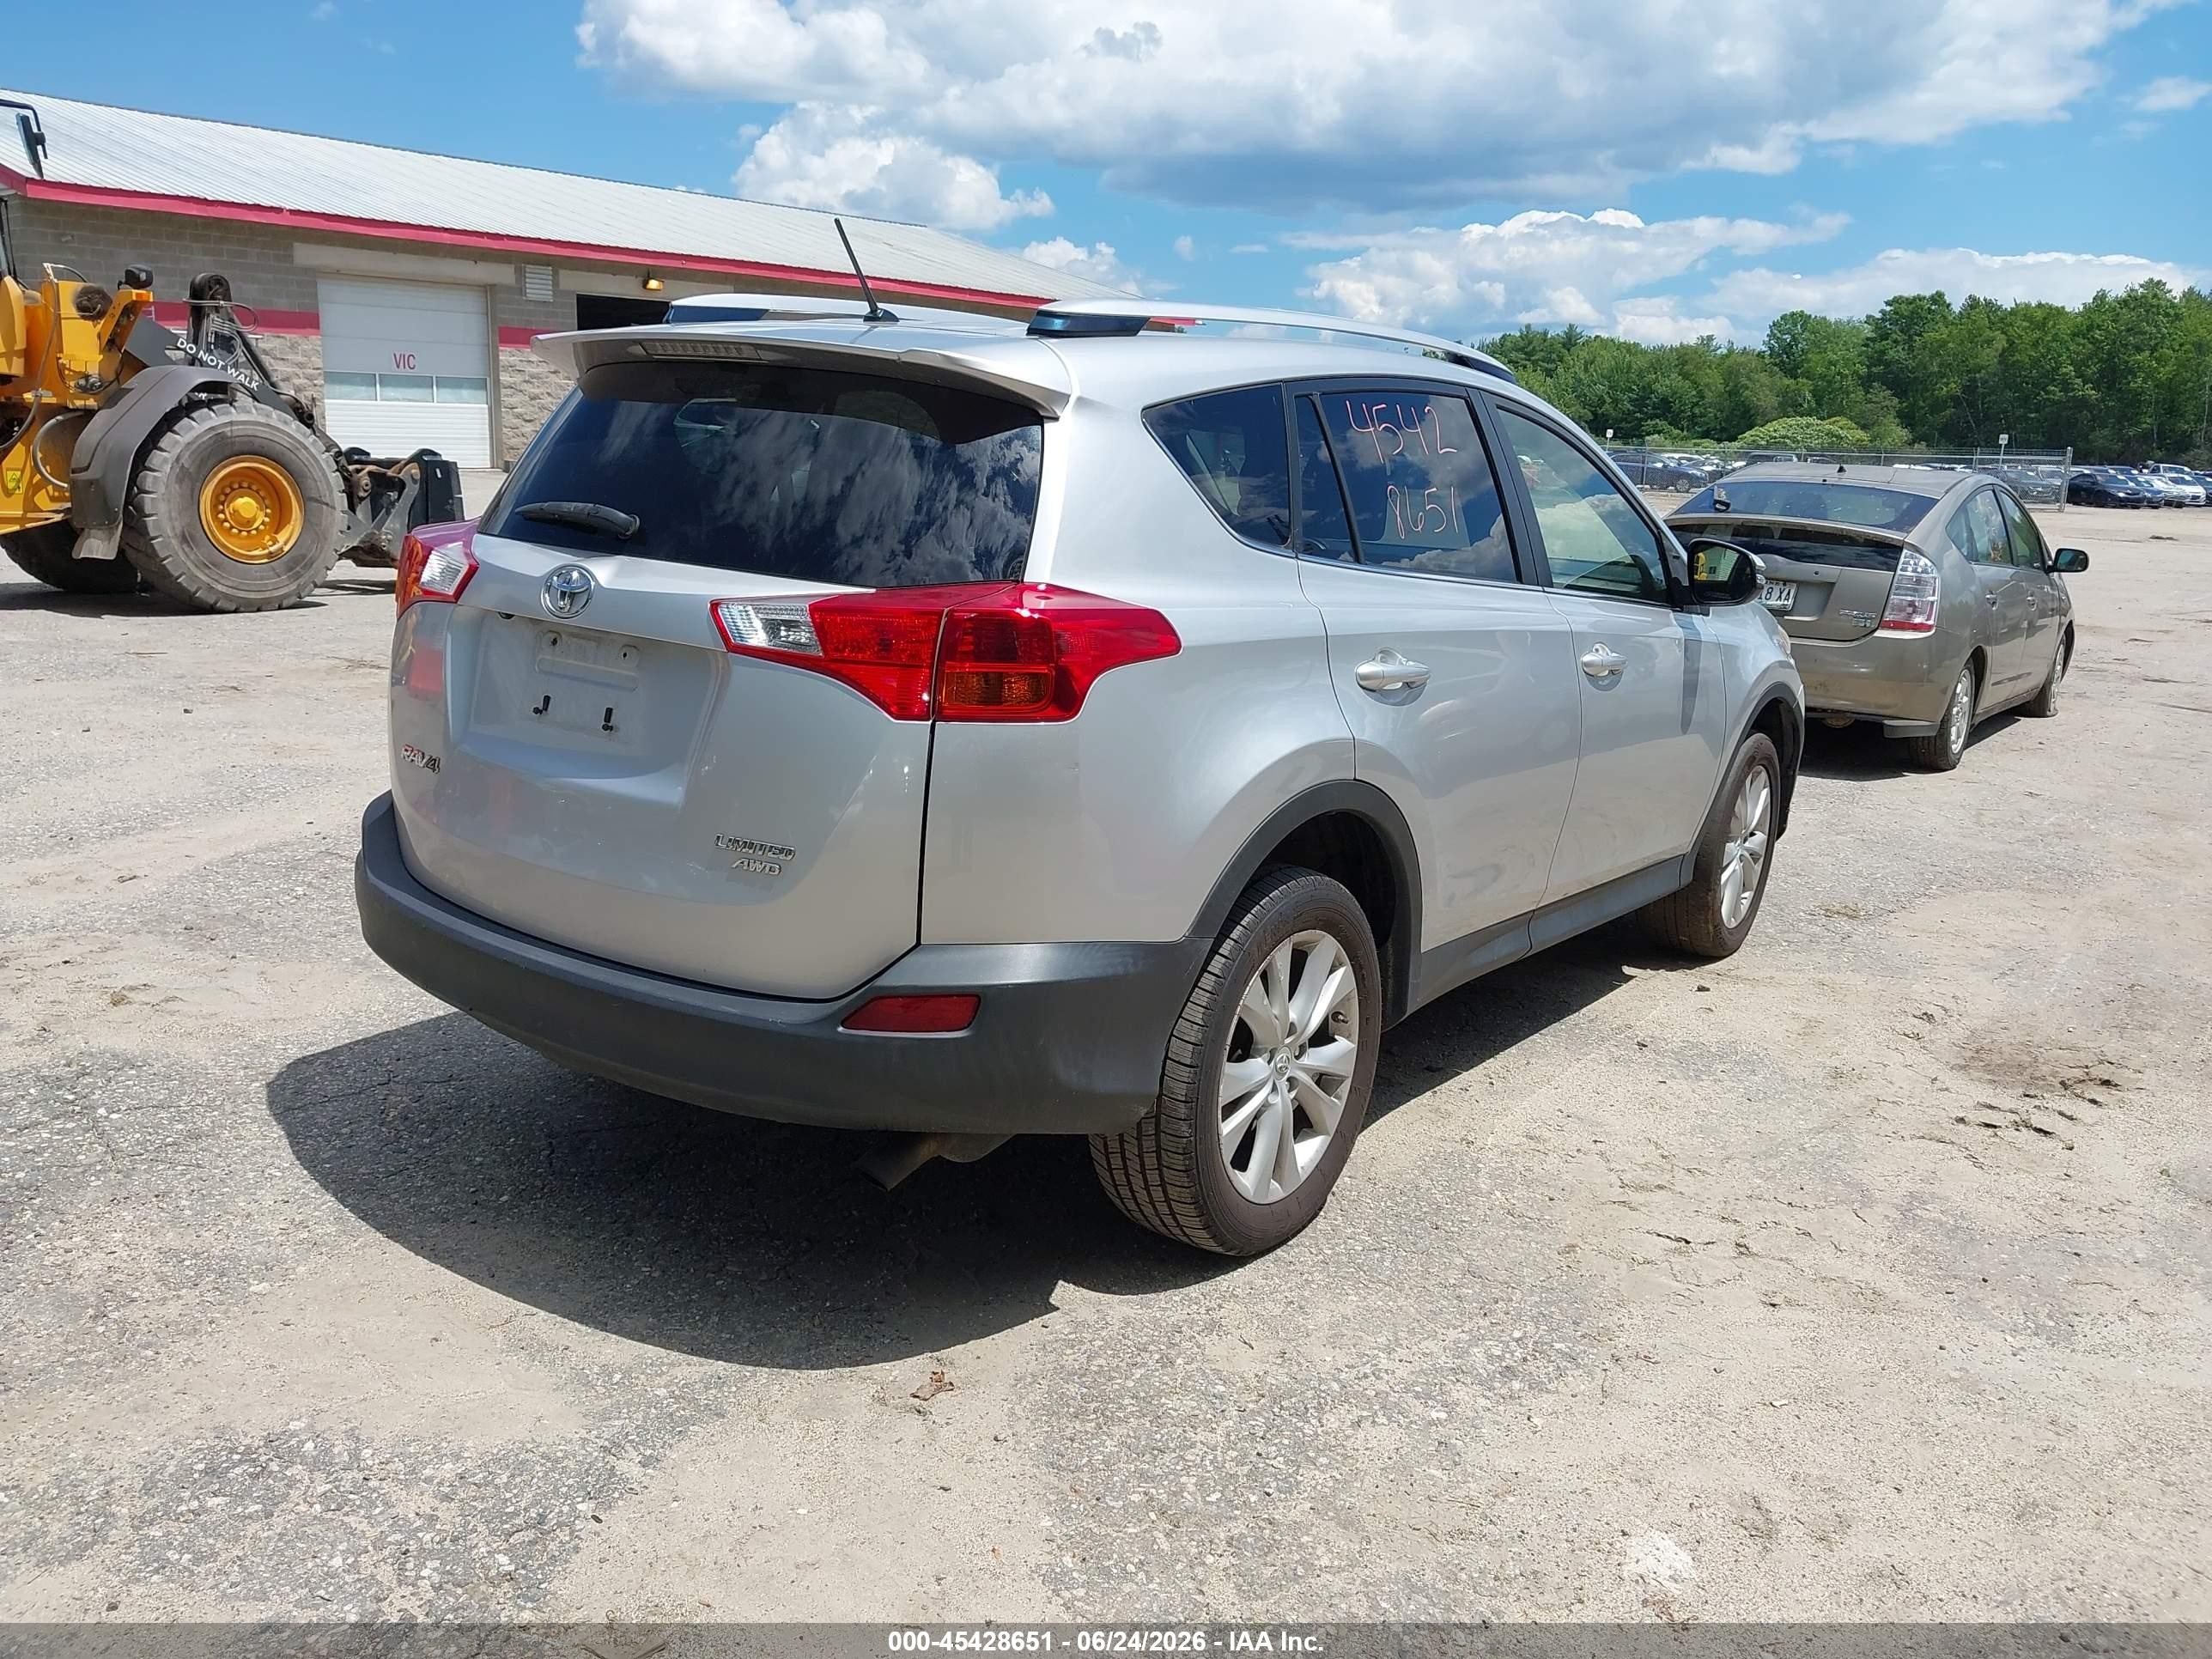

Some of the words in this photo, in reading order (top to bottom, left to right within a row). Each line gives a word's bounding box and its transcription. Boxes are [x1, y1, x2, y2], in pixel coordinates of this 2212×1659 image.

[177, 337, 197, 354] DO
[198, 349, 226, 370] NOT
[227, 365, 260, 392] WALK
[392, 352, 416, 370] VIC
[1346, 400, 1458, 465] 4542
[1387, 485, 1459, 539] 8651
[1775, 587, 1791, 603] XA
[401, 743, 441, 774] RAV4
[714, 833, 797, 860] LIMITED
[731, 857, 782, 876] AWD
